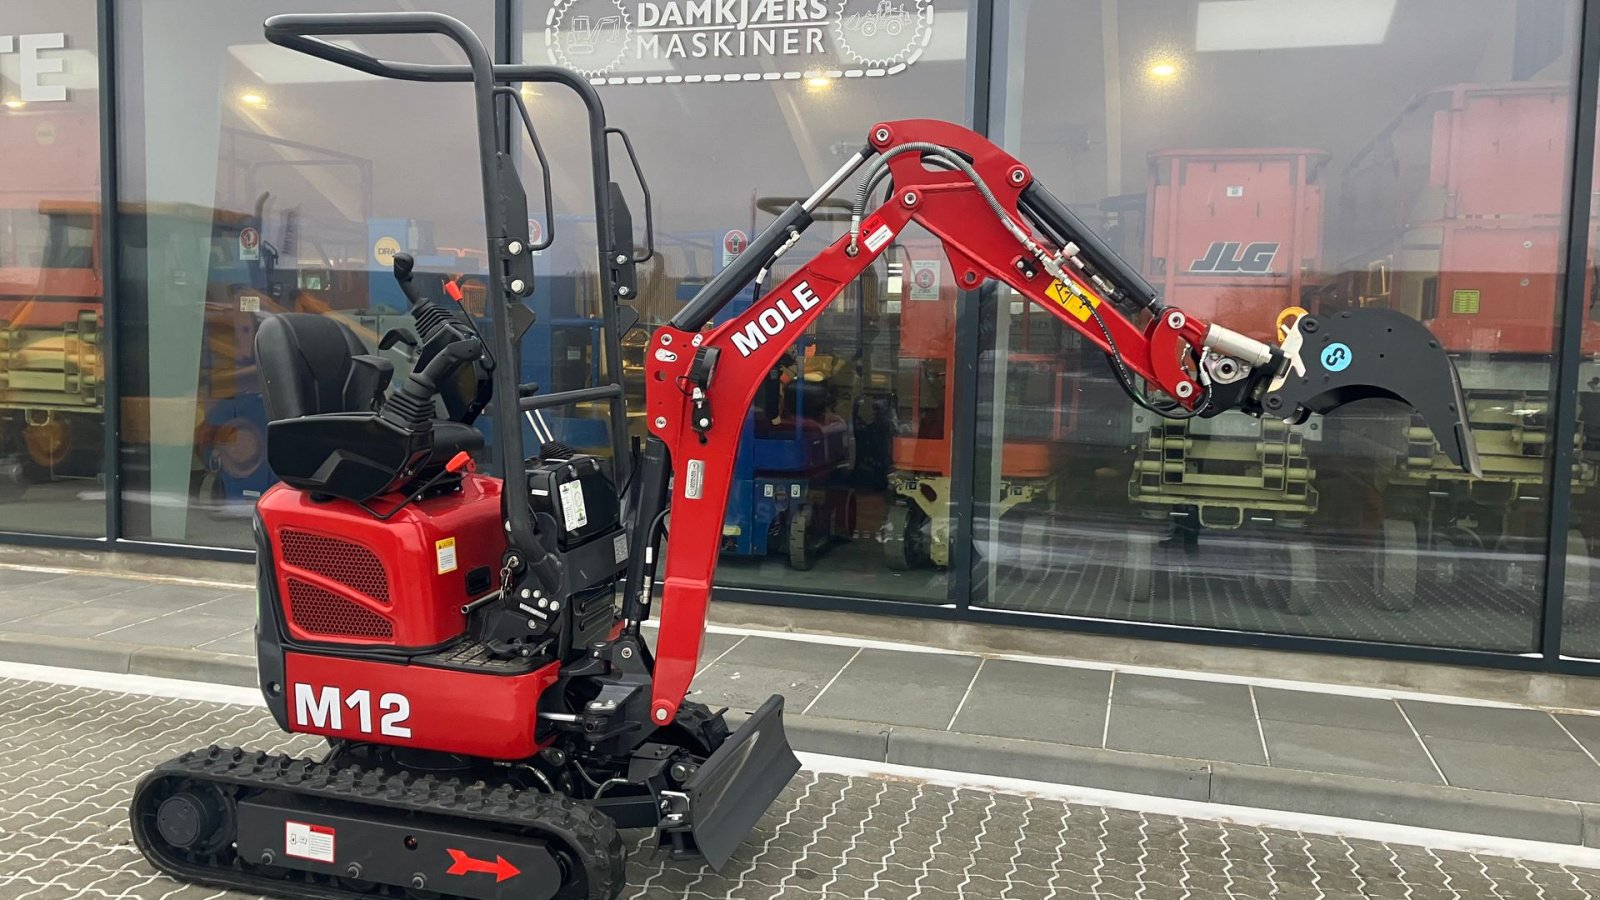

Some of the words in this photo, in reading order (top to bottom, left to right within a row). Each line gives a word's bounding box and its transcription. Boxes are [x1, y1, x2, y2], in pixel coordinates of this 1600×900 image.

[638, 0, 828, 30] DAMKJÆRS
[636, 28, 826, 59] MASKINER
[1189, 241, 1280, 273] JLG
[730, 280, 820, 358] MOLE
[293, 682, 412, 739] M12
